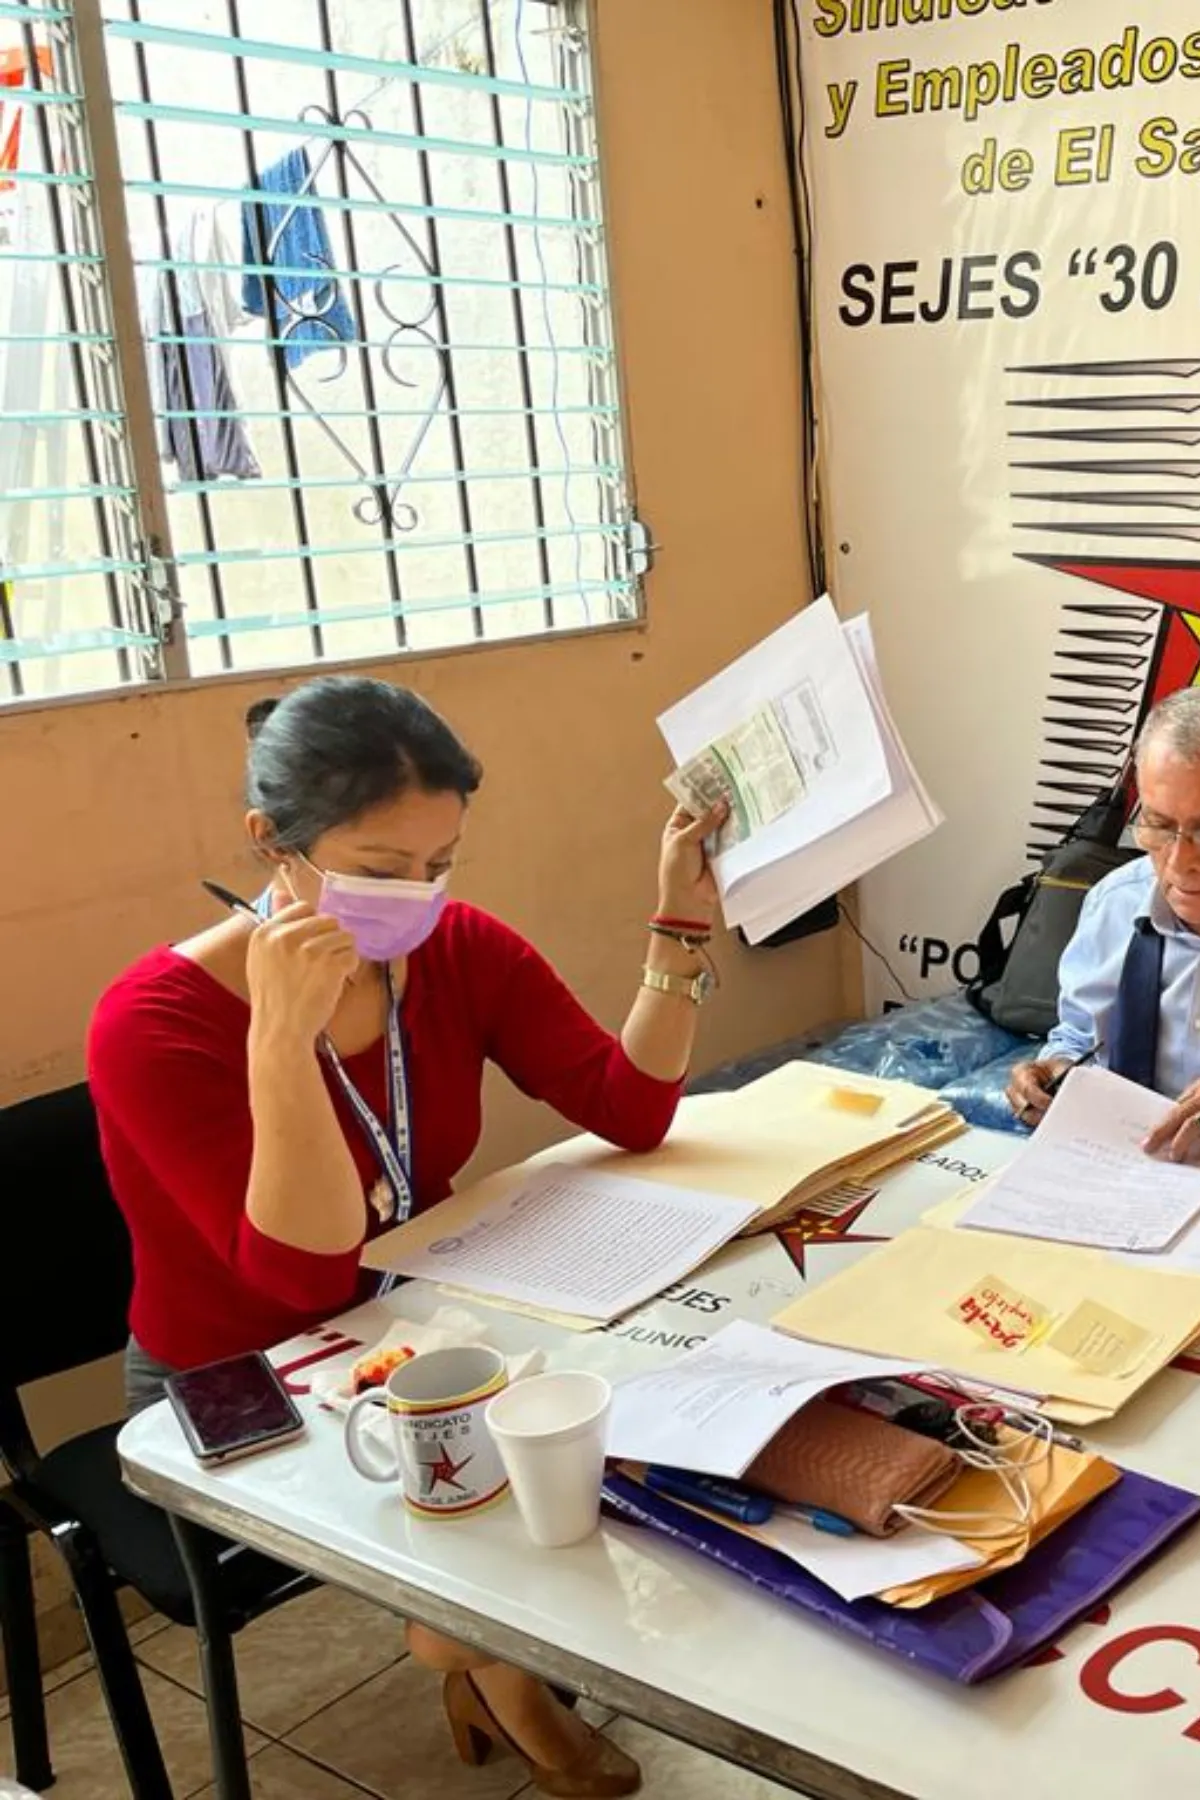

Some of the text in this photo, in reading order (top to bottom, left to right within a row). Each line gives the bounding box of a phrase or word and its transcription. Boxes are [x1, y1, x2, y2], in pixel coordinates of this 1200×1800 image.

[825, 81, 857, 138] y
[962, 137, 1034, 195] de
[1054, 123, 1115, 186] El
[839, 250, 1041, 327] SEJES
[1066, 241, 1179, 313] “30
